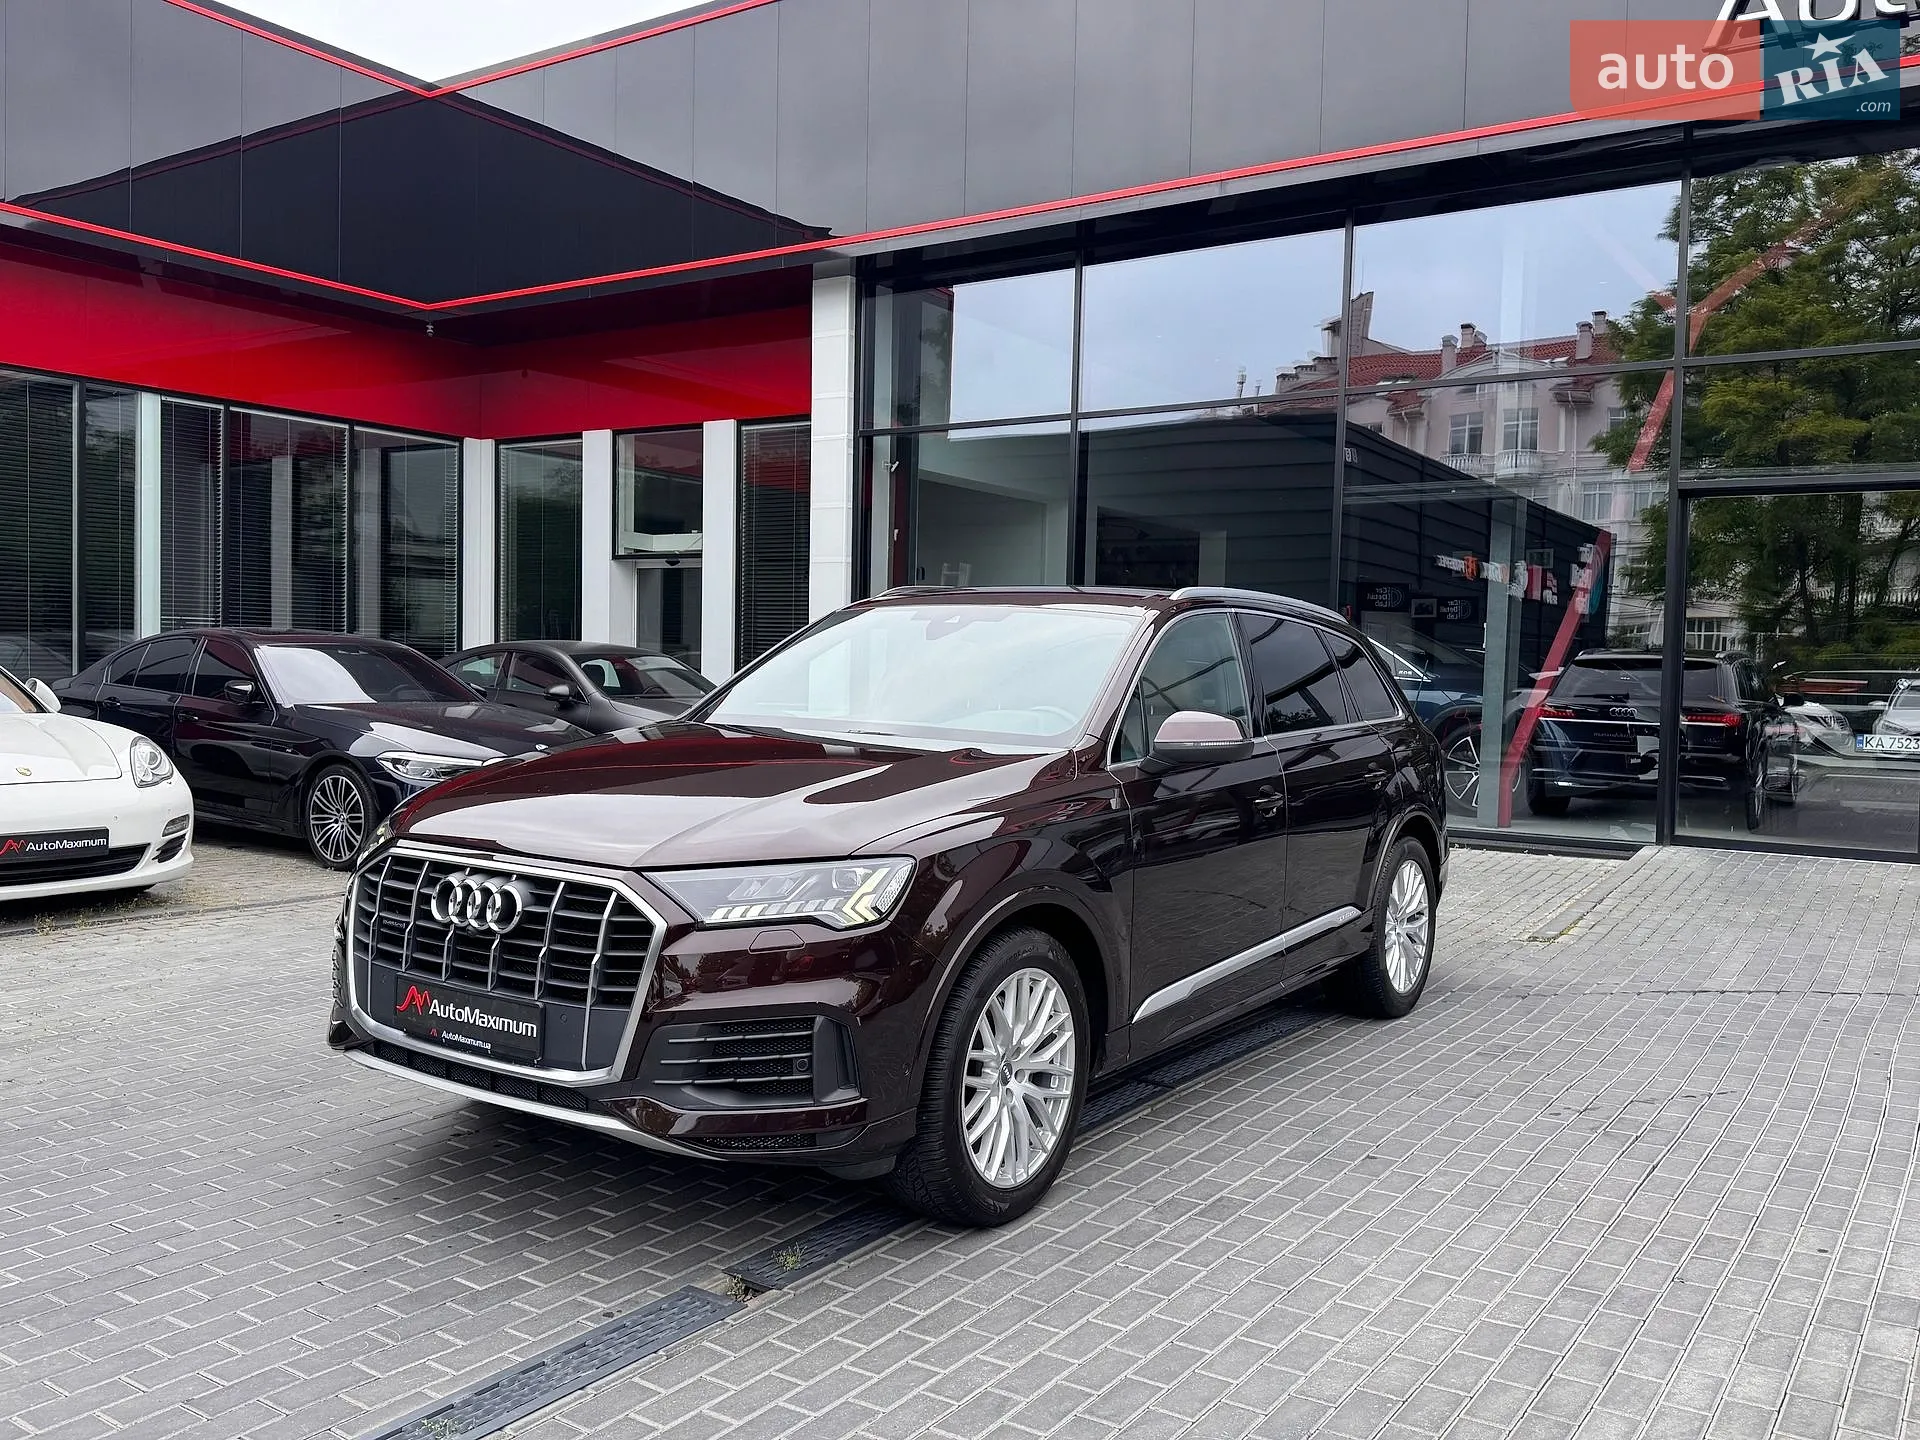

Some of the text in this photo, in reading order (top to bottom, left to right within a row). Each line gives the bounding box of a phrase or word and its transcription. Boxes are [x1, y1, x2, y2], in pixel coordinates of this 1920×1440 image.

[1865, 736, 1920, 750] KA 7523
[25, 837, 107, 852] AutoMaximum
[428, 999, 537, 1038] AutoMaximum
